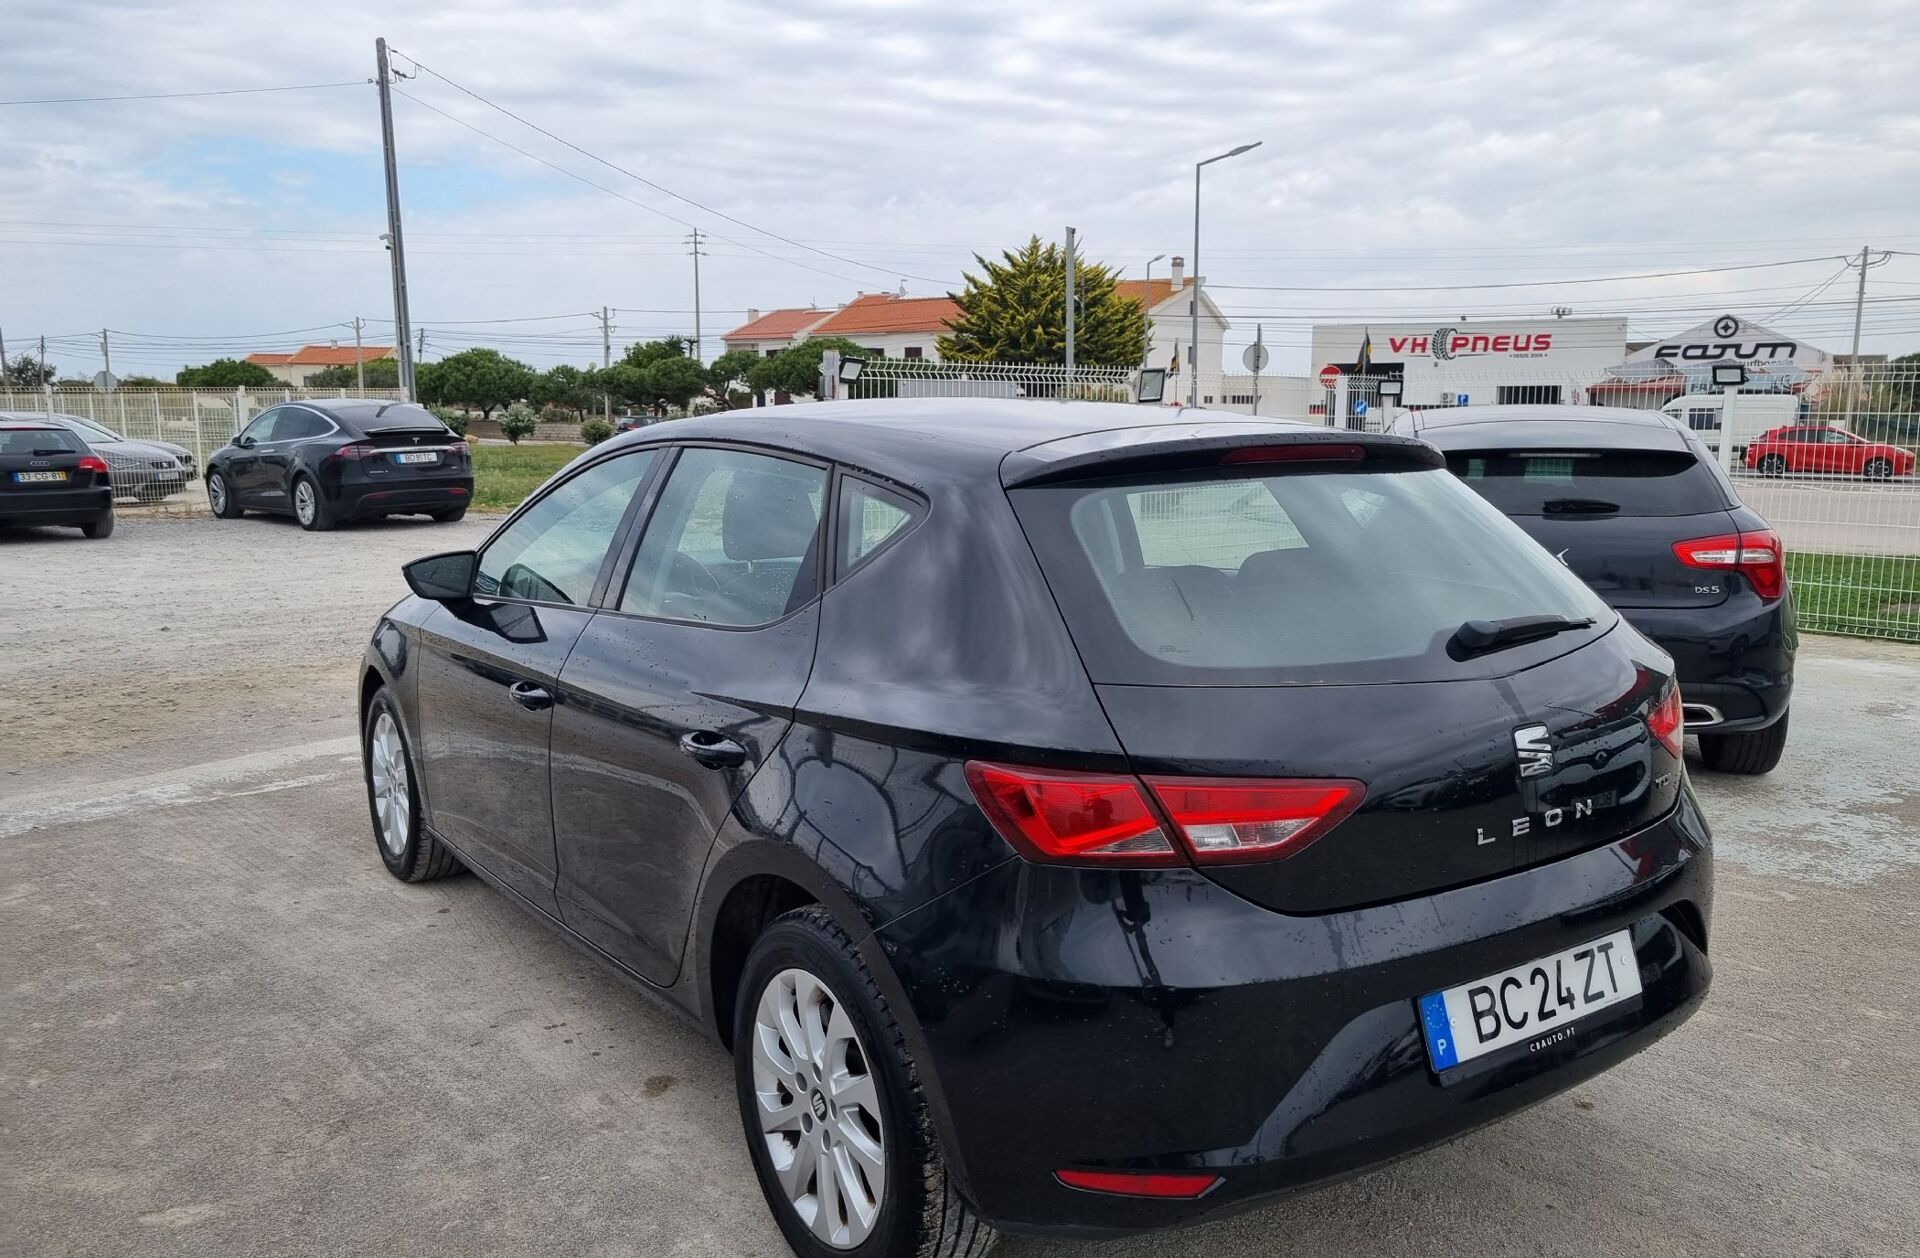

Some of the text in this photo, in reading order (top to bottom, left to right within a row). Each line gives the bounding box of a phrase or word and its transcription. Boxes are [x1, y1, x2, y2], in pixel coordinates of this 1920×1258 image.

[1389, 334, 1552, 353] VH PNEUS
[1477, 799, 1593, 846] LEON
[1468, 941, 1618, 1044] BC24ZT
[1437, 1038, 1447, 1056] P
[1530, 1027, 1576, 1052] CBAUTO.PT
